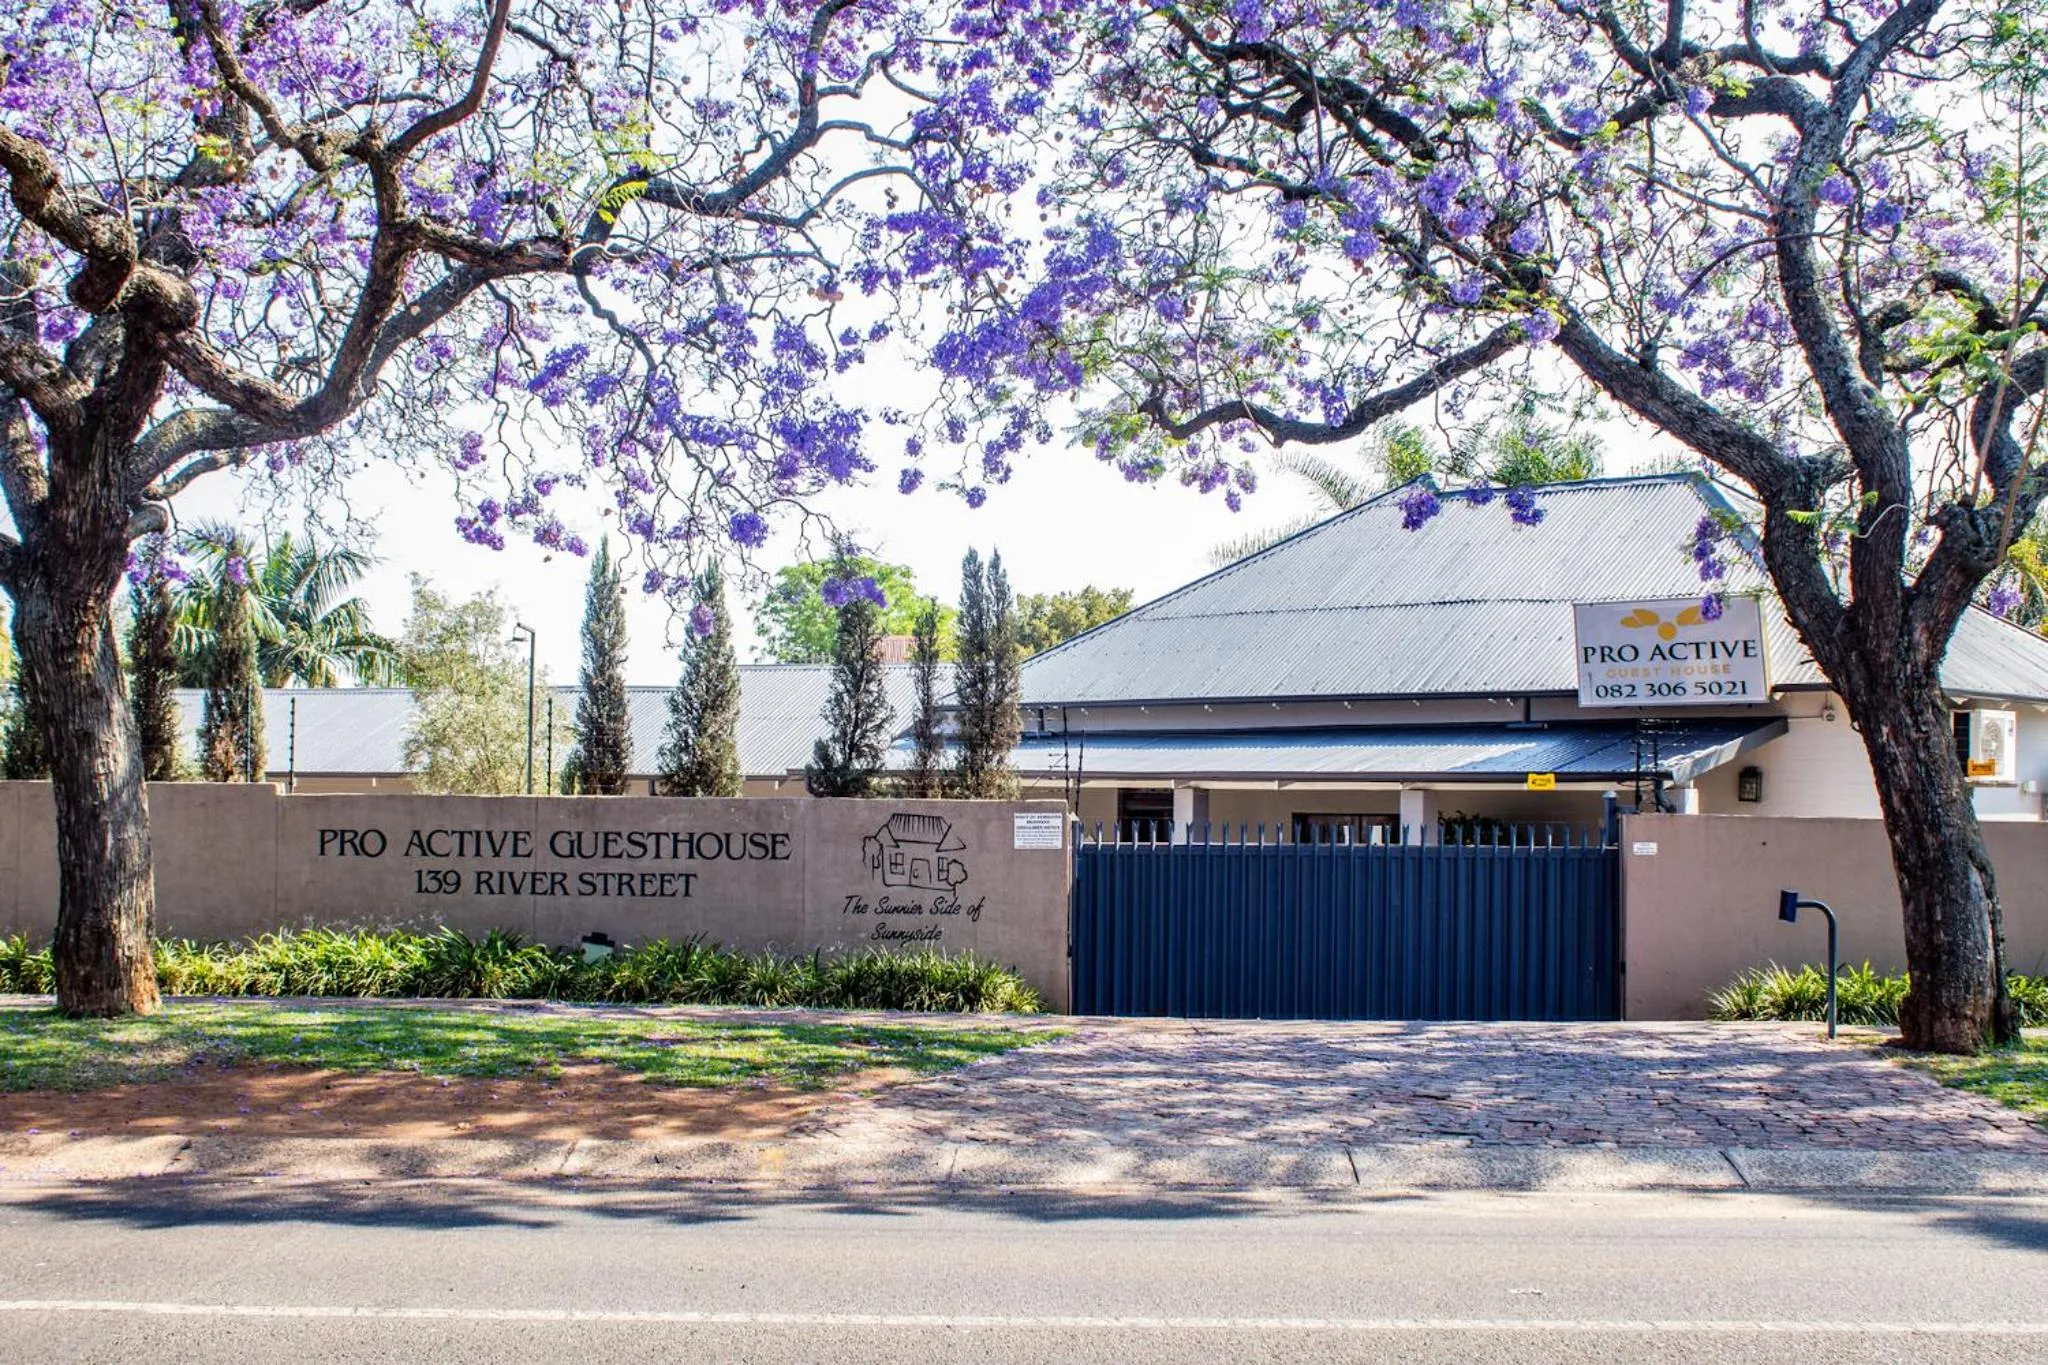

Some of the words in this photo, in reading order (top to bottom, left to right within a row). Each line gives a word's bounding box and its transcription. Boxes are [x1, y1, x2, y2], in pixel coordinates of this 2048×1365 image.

[1584, 645, 1639, 663] PRO
[1650, 640, 1757, 661] ACTIVE
[1606, 666, 1661, 678] GUEST
[1671, 664, 1732, 676] HOUSE
[1595, 683, 1638, 699] 082
[1645, 682, 1687, 697] 306
[1693, 680, 1748, 696] 5021
[318, 828, 387, 858] PRO
[403, 829, 534, 859] ACTIVE
[549, 830, 793, 861] GUESTHOUSE
[414, 869, 462, 895] 139
[474, 870, 570, 896] RIVER
[577, 872, 699, 898] STREET
[843, 894, 869, 915] The
[874, 896, 923, 916] Sunnier
[929, 895, 962, 915] Side
[966, 896, 986, 922] of
[871, 922, 943, 948] Sunnyside
